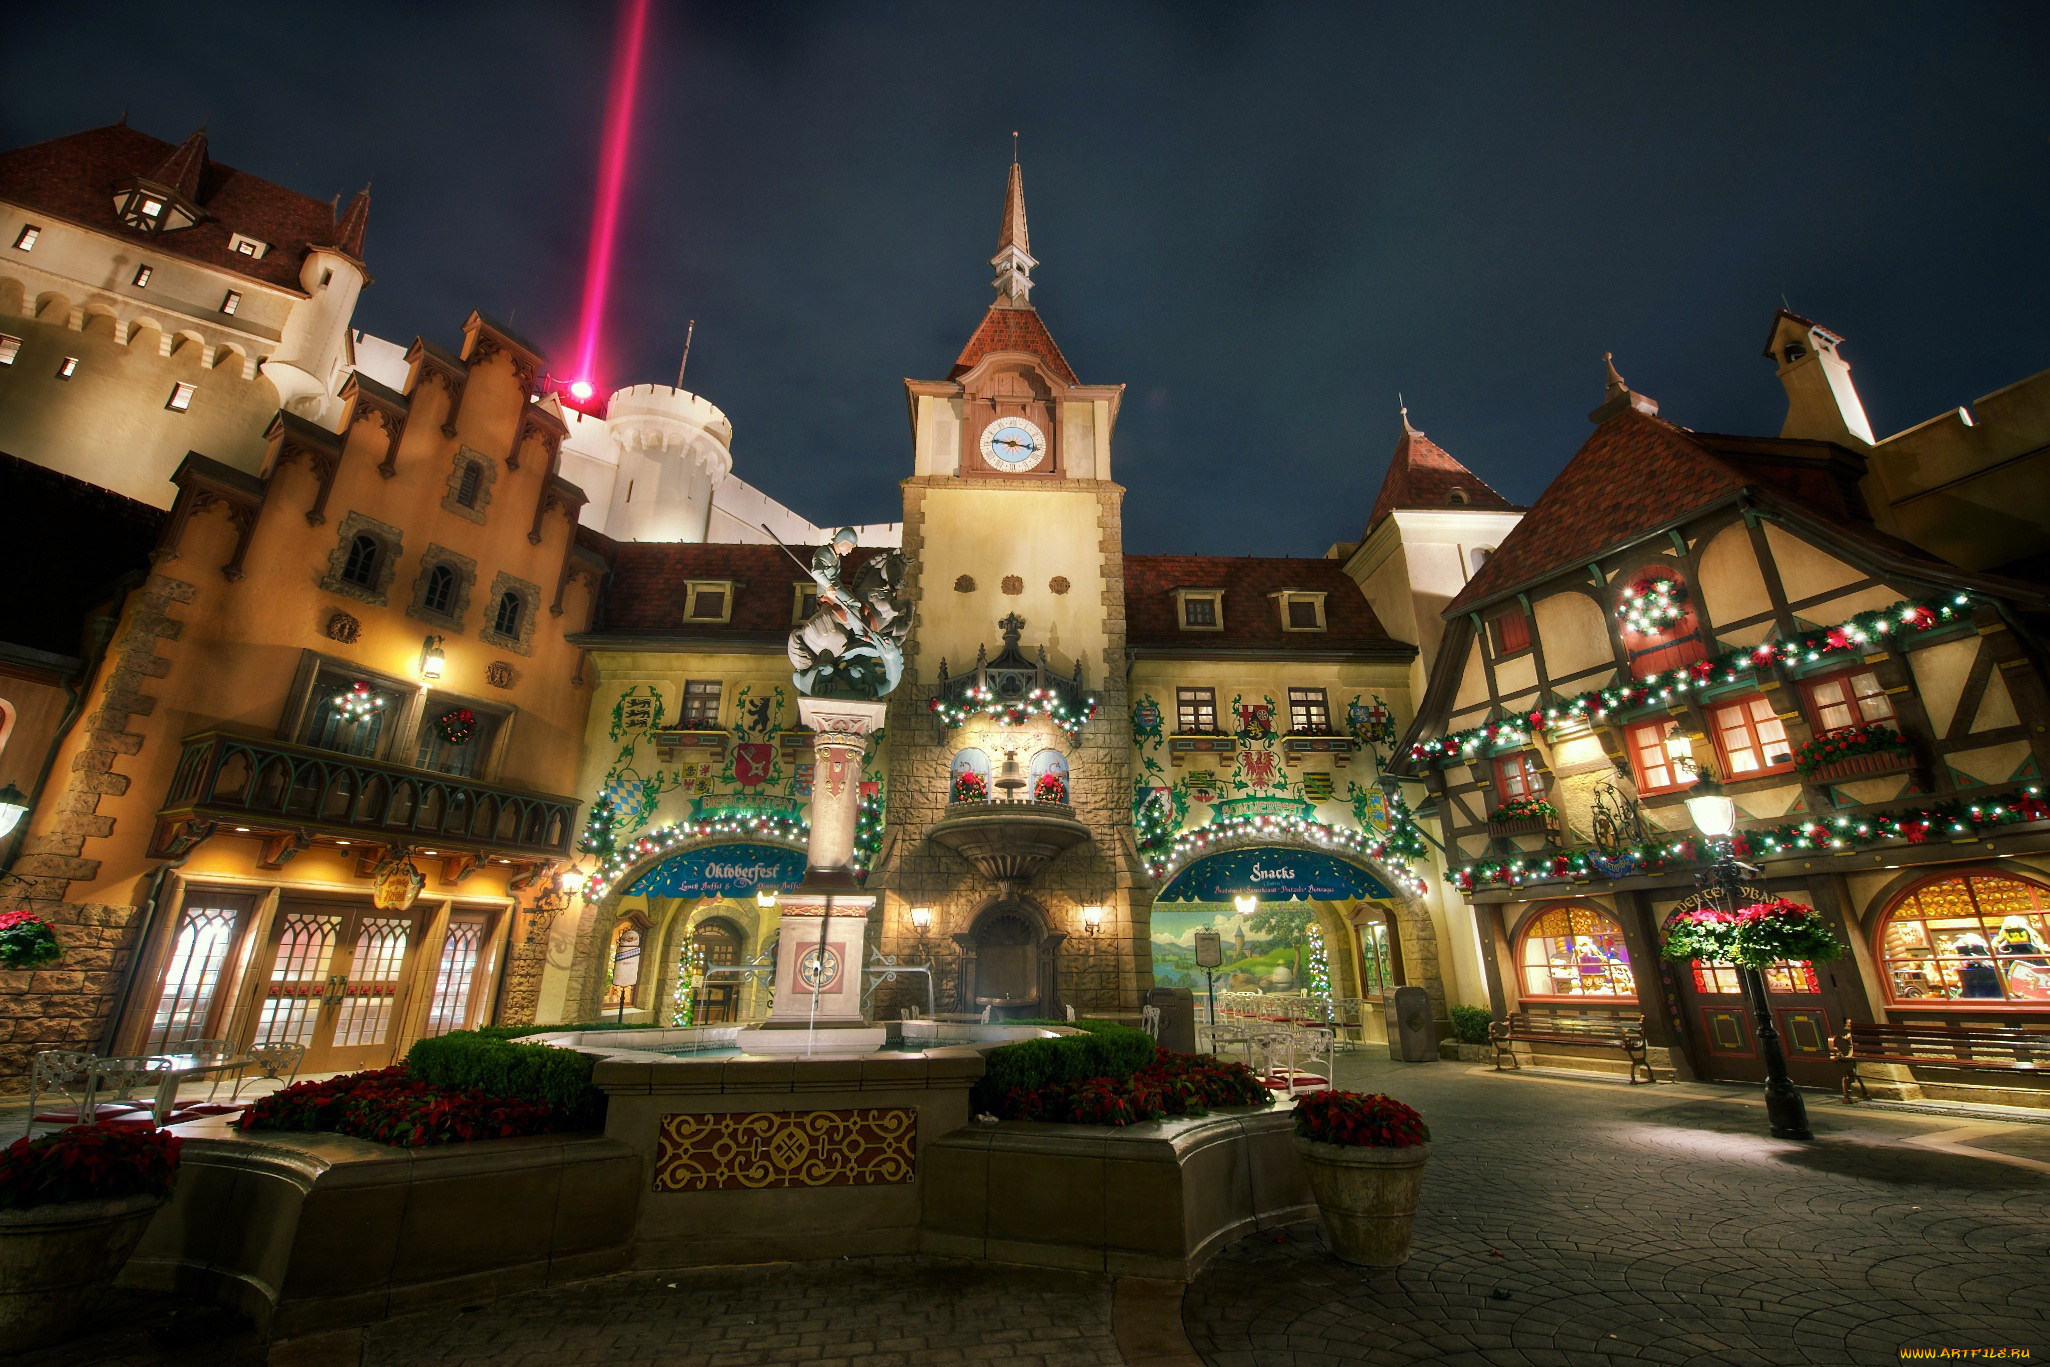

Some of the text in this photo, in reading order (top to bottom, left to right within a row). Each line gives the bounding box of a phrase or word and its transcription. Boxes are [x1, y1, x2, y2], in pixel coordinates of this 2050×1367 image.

[702, 794, 795, 812] BIERGARTEN
[717, 808, 774, 817] RESTAURANT
[1222, 801, 1306, 819] SOMMERFEST
[704, 861, 780, 887] Oktoberfest
[1249, 861, 1296, 883] Snacks
[1676, 893, 1703, 913] DER
